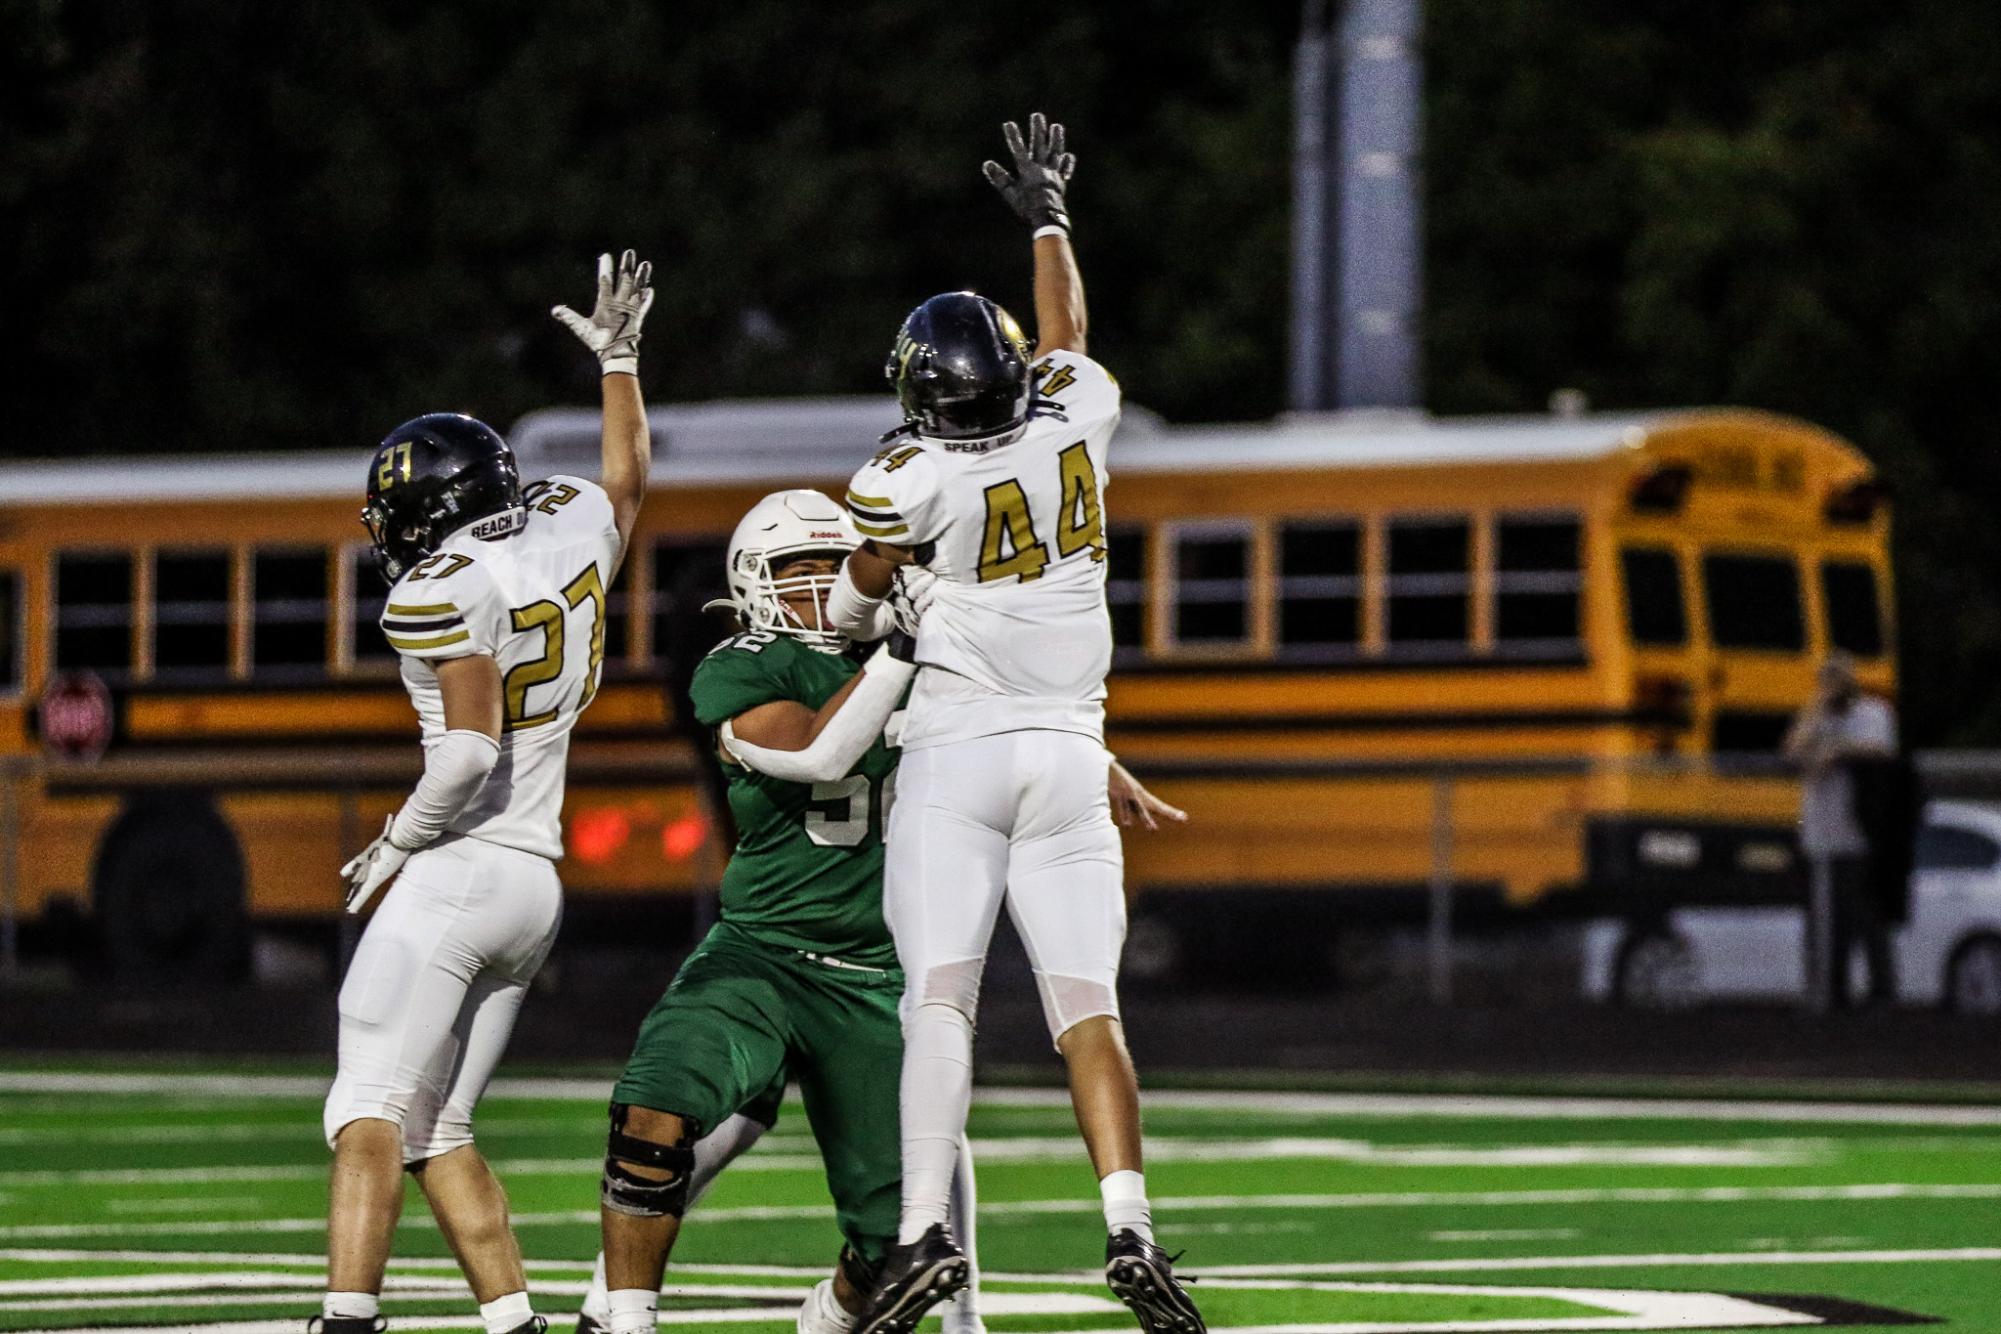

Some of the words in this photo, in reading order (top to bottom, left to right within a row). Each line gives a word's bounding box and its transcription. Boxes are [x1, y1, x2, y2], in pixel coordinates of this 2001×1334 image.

[378, 441, 413, 491] 27
[944, 441, 989, 453] SPEAK
[471, 514, 513, 538] REACH
[978, 440, 1107, 583] 44
[407, 553, 476, 582] 27
[502, 560, 606, 733] 27
